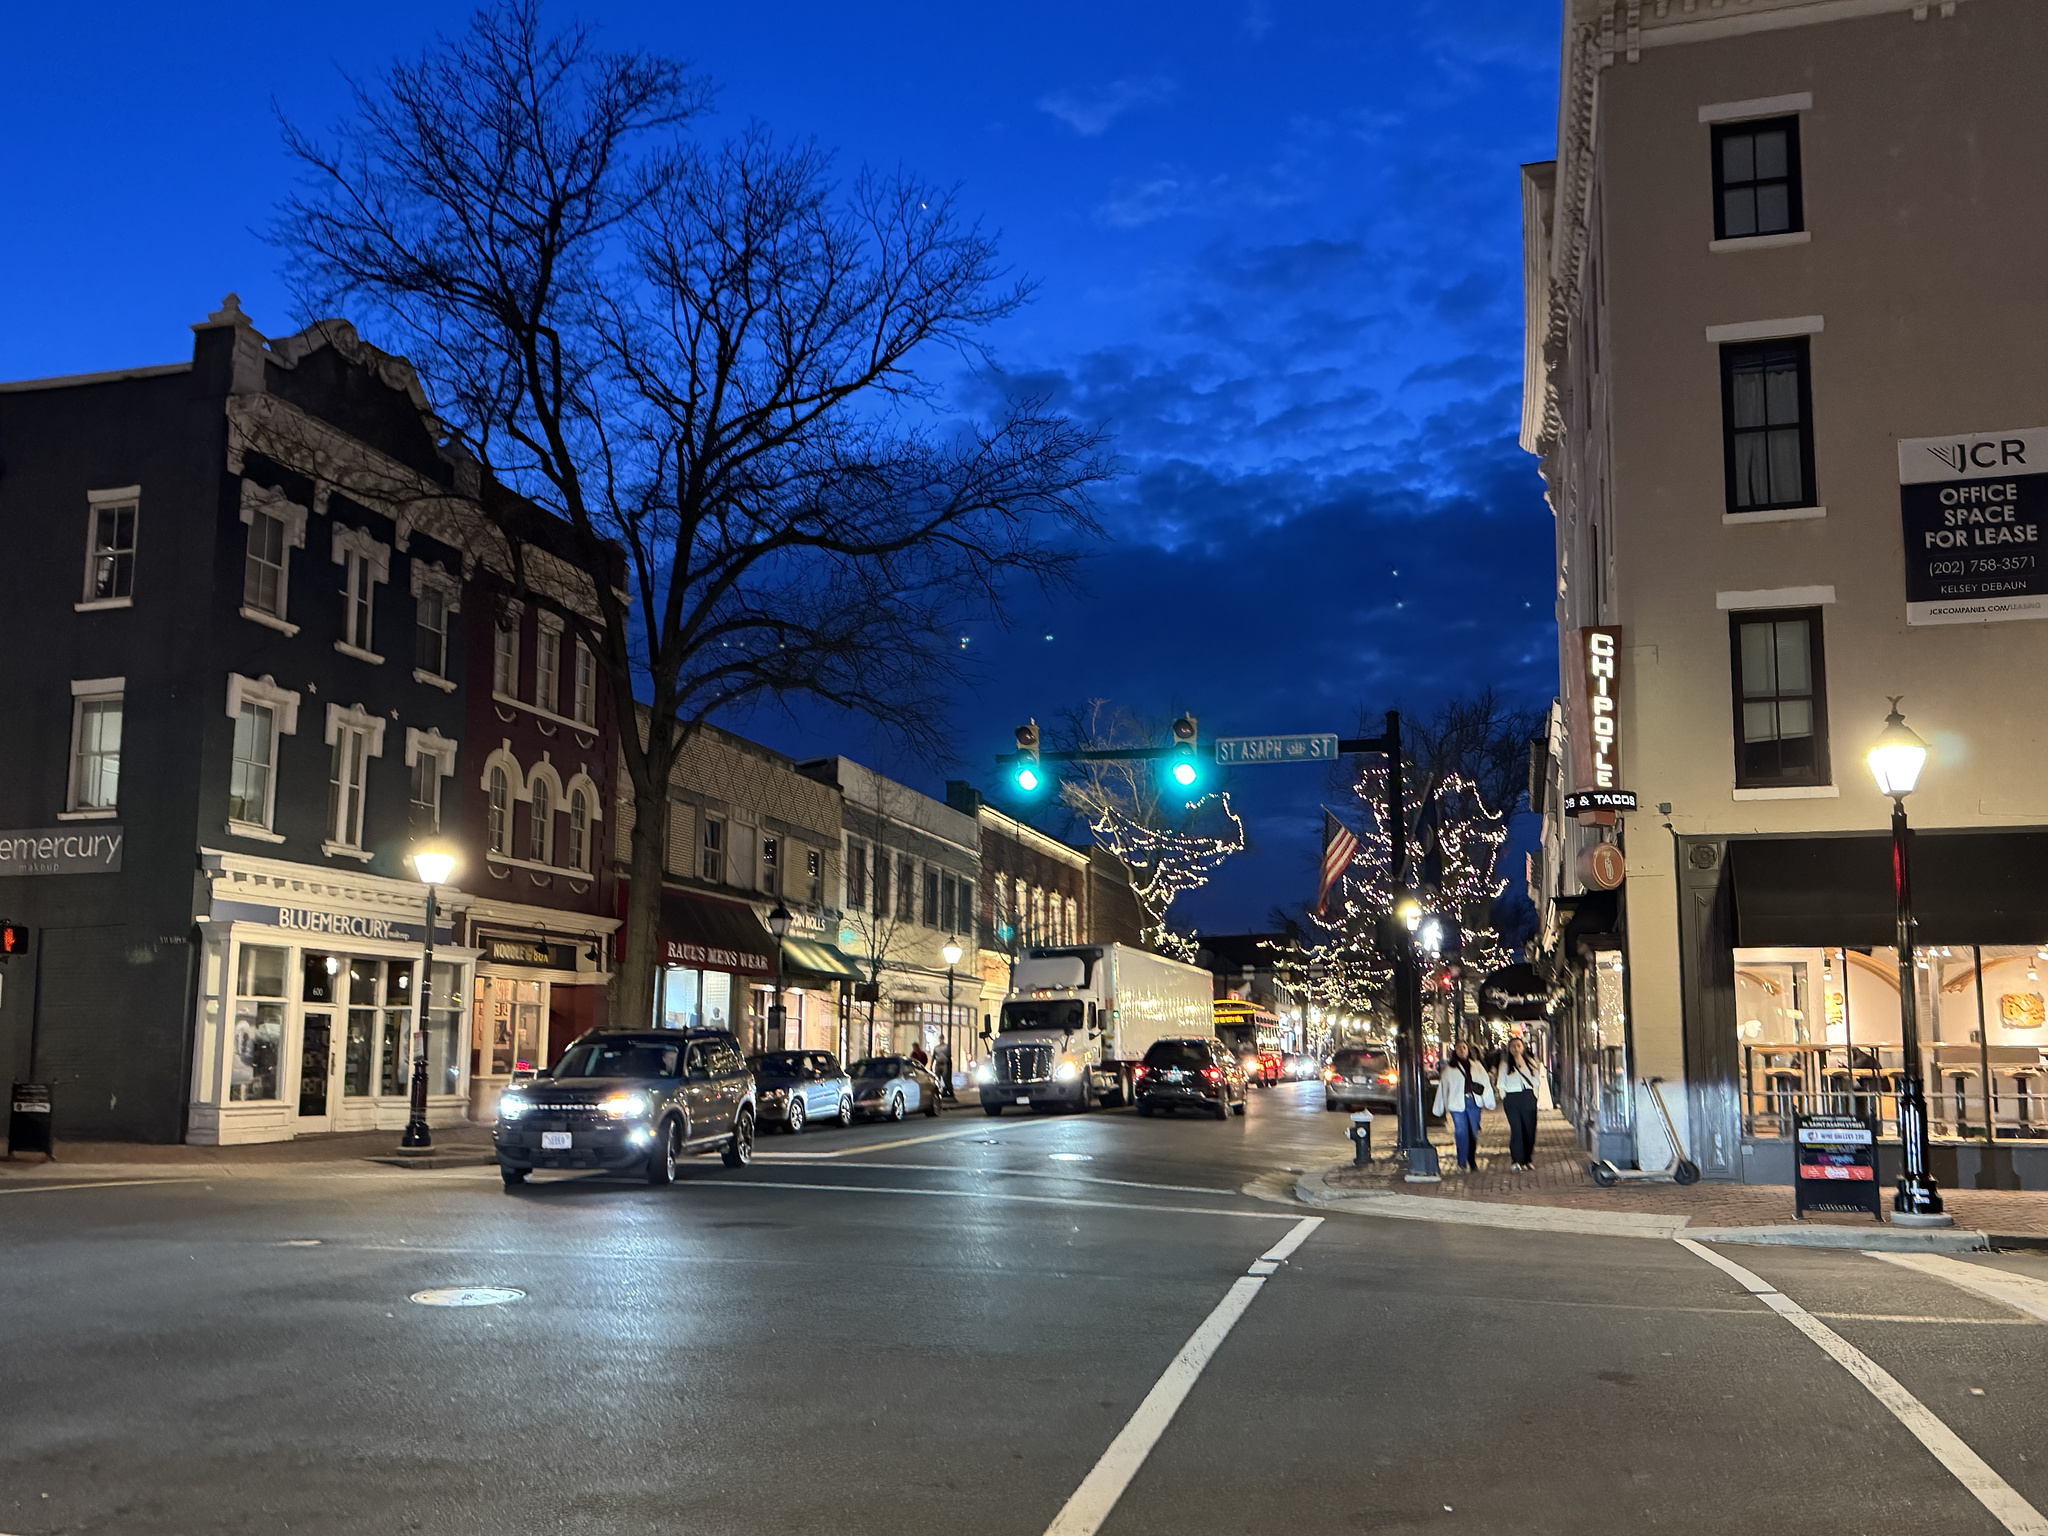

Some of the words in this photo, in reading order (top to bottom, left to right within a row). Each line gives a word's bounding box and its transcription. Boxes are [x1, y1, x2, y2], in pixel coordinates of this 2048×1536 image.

[1957, 439, 2027, 473] JCR
[1939, 483, 2018, 505] OFFICE
[1944, 505, 2016, 526] SPACE
[1925, 530, 1969, 549] FOR
[1974, 524, 2038, 545] LEASE
[1929, 560, 1965, 577] (202)
[1970, 555, 2036, 573] 758-3571
[1940, 583, 1978, 594] KELSEY
[1981, 580, 2027, 592] DEBAUN
[1590, 632, 1615, 789] CHIPOTLE
[1220, 742, 1236, 761] ST
[1241, 739, 1282, 760] ASAPH
[1309, 739, 1331, 758] ST
[1579, 795, 1590, 806] &
[1593, 793, 1636, 807] TACOS
[19, 862, 61, 873] makeup
[279, 907, 392, 940] BLUEMERCURY
[805, 914, 826, 932] ROLLS
[493, 943, 526, 960] NOODLE
[739, 952, 769, 971] WEAR
[312, 987, 324, 997] 600
